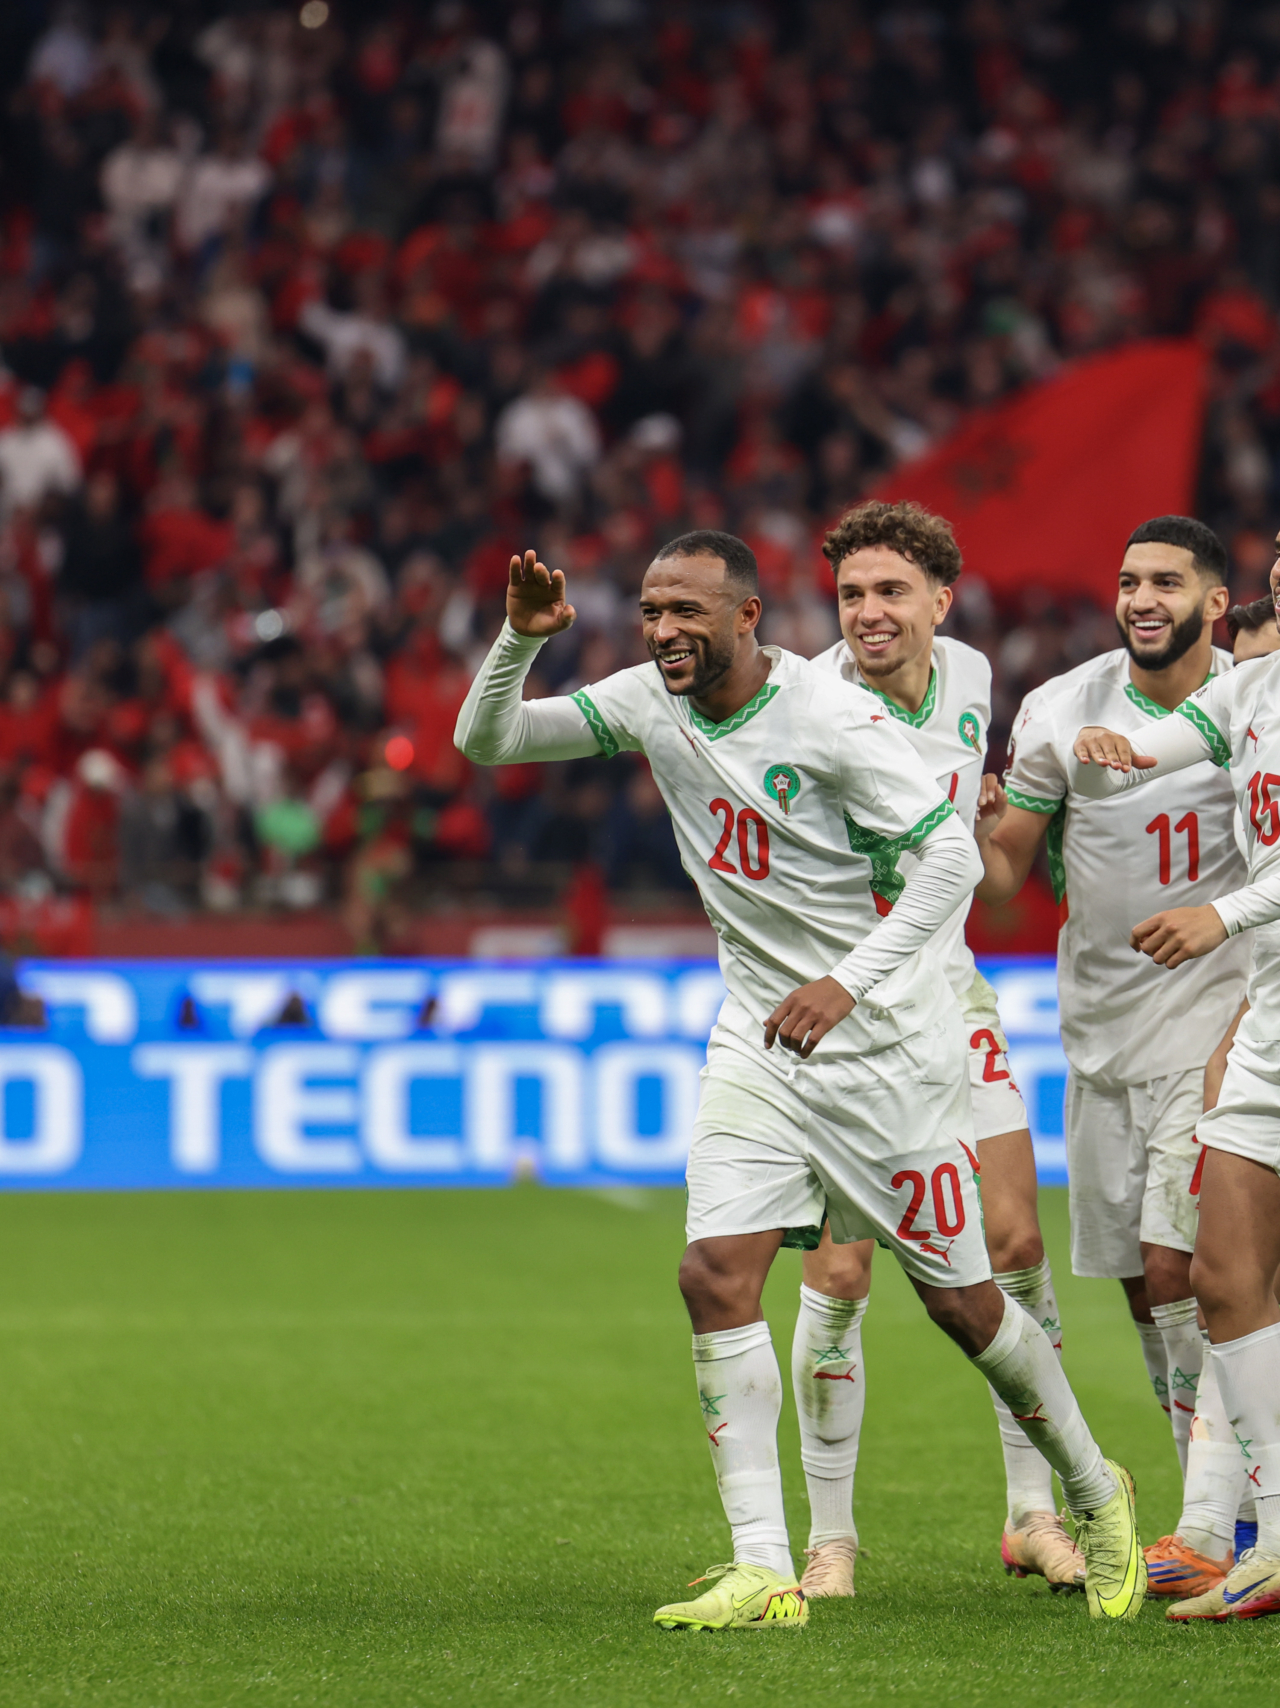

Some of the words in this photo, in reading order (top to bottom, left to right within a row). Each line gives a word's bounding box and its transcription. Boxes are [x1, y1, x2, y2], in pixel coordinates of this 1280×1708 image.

[709, 798, 770, 880] 20
[1248, 771, 1280, 846] 15
[1146, 812, 1199, 885] 11
[132, 1042, 703, 1174] TECNO
[891, 1162, 966, 1240] 20
